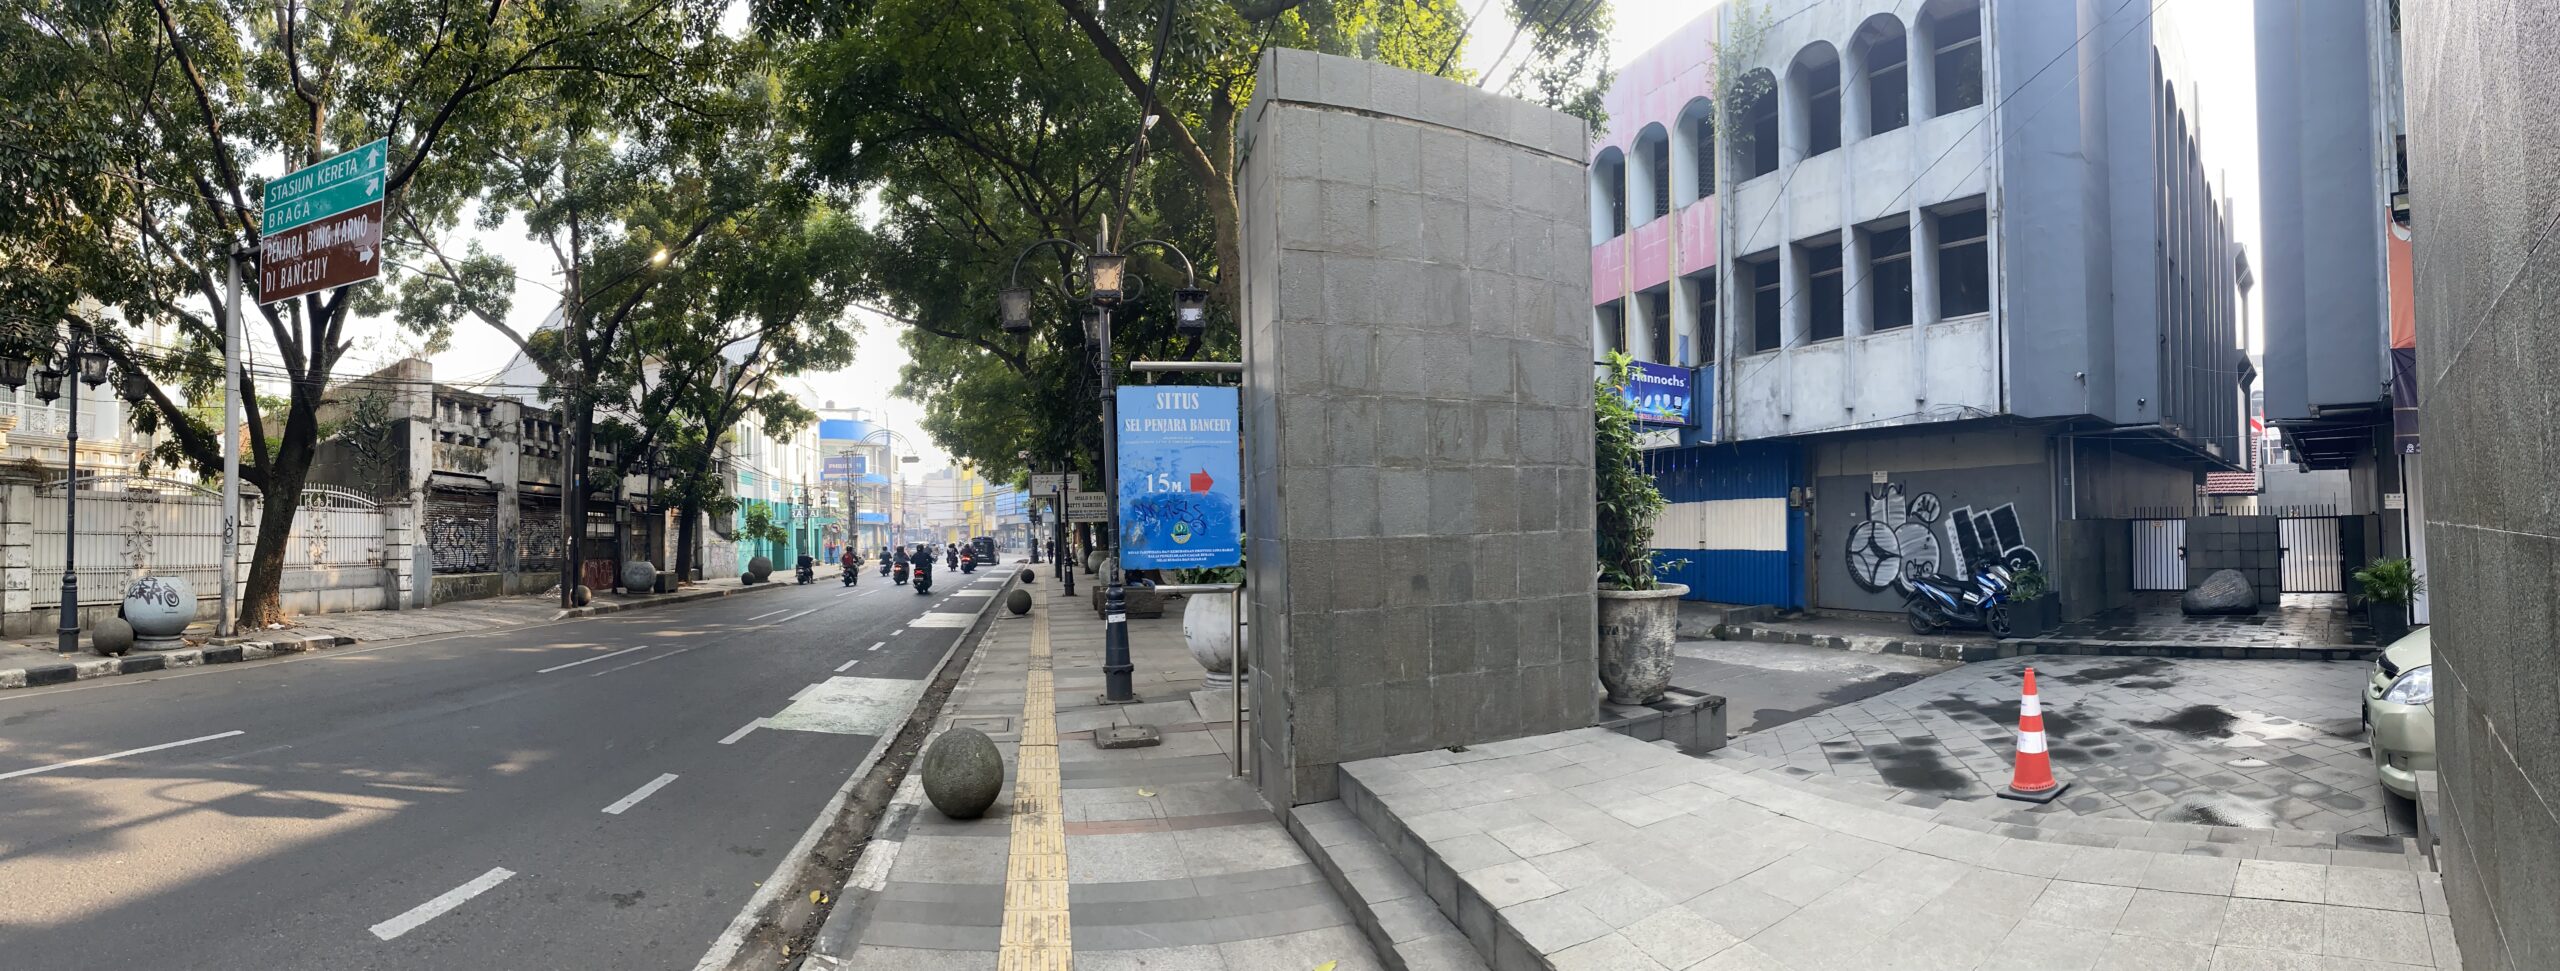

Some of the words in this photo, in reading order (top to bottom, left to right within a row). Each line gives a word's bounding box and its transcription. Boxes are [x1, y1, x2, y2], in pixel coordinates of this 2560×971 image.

[270, 173, 313, 203] STASIUN
[317, 157, 358, 182] KERETA
[268, 202, 310, 229] BRAGA
[266, 234, 303, 265] PENJARA
[307, 225, 331, 252] BUNG
[334, 214, 368, 245] KARNO
[265, 271, 276, 293] DI
[280, 256, 328, 289] BANCEUY
[1631, 373, 1685, 388] Hannochs
[1156, 392, 1199, 410] SITUS
[1125, 418, 1142, 432] SEL
[1144, 418, 1187, 433] PENJARA
[1190, 418, 1232, 432] BANCEUY
